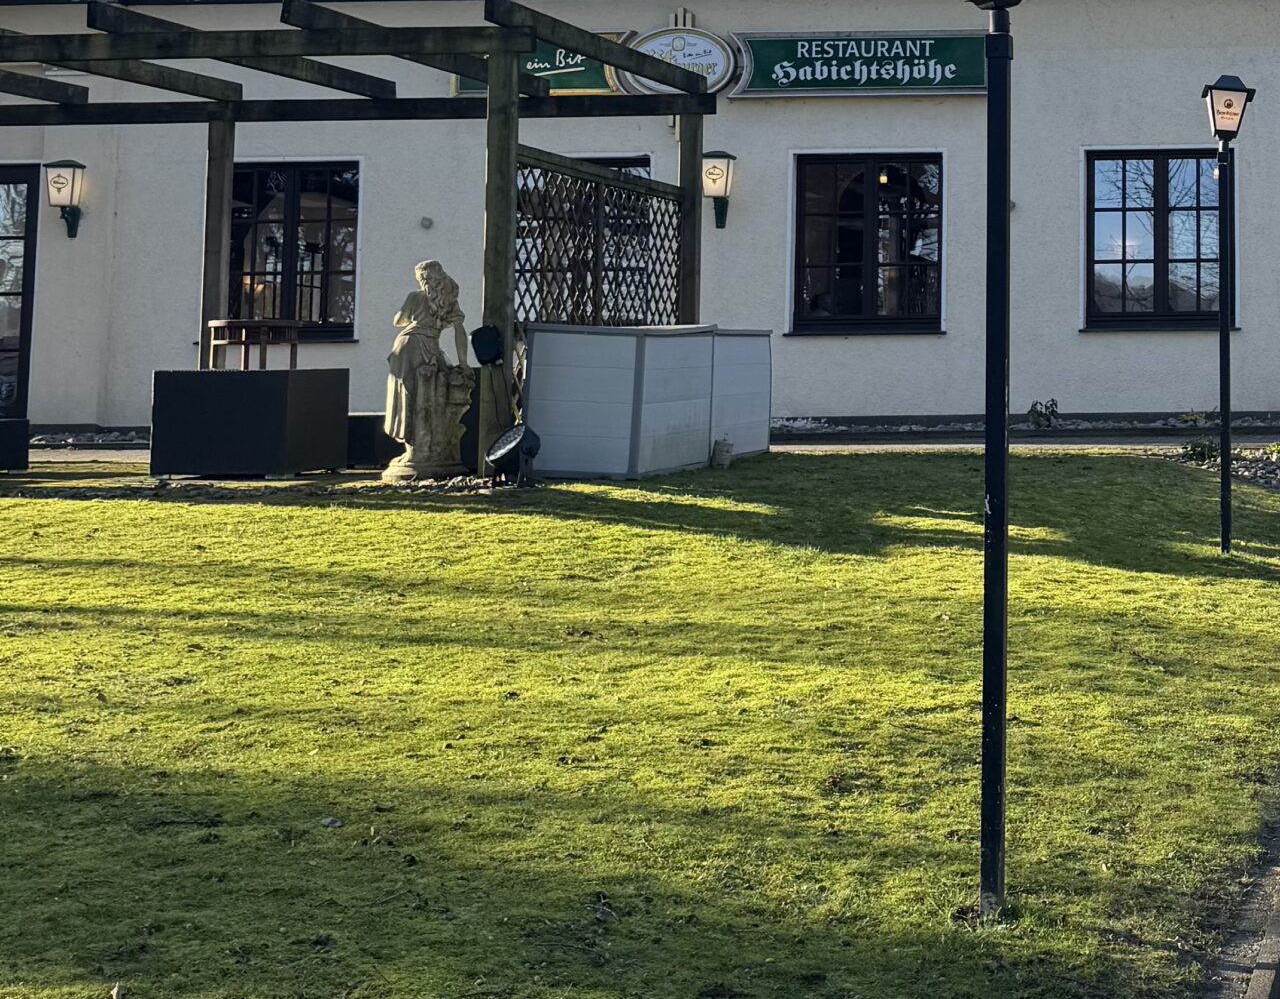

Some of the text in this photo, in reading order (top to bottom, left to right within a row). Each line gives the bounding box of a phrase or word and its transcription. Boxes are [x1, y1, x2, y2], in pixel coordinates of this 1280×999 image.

[526, 48, 587, 70] ein Bit
[797, 39, 935, 58] RESTAURANT
[771, 58, 957, 87] Habichtshöhe
